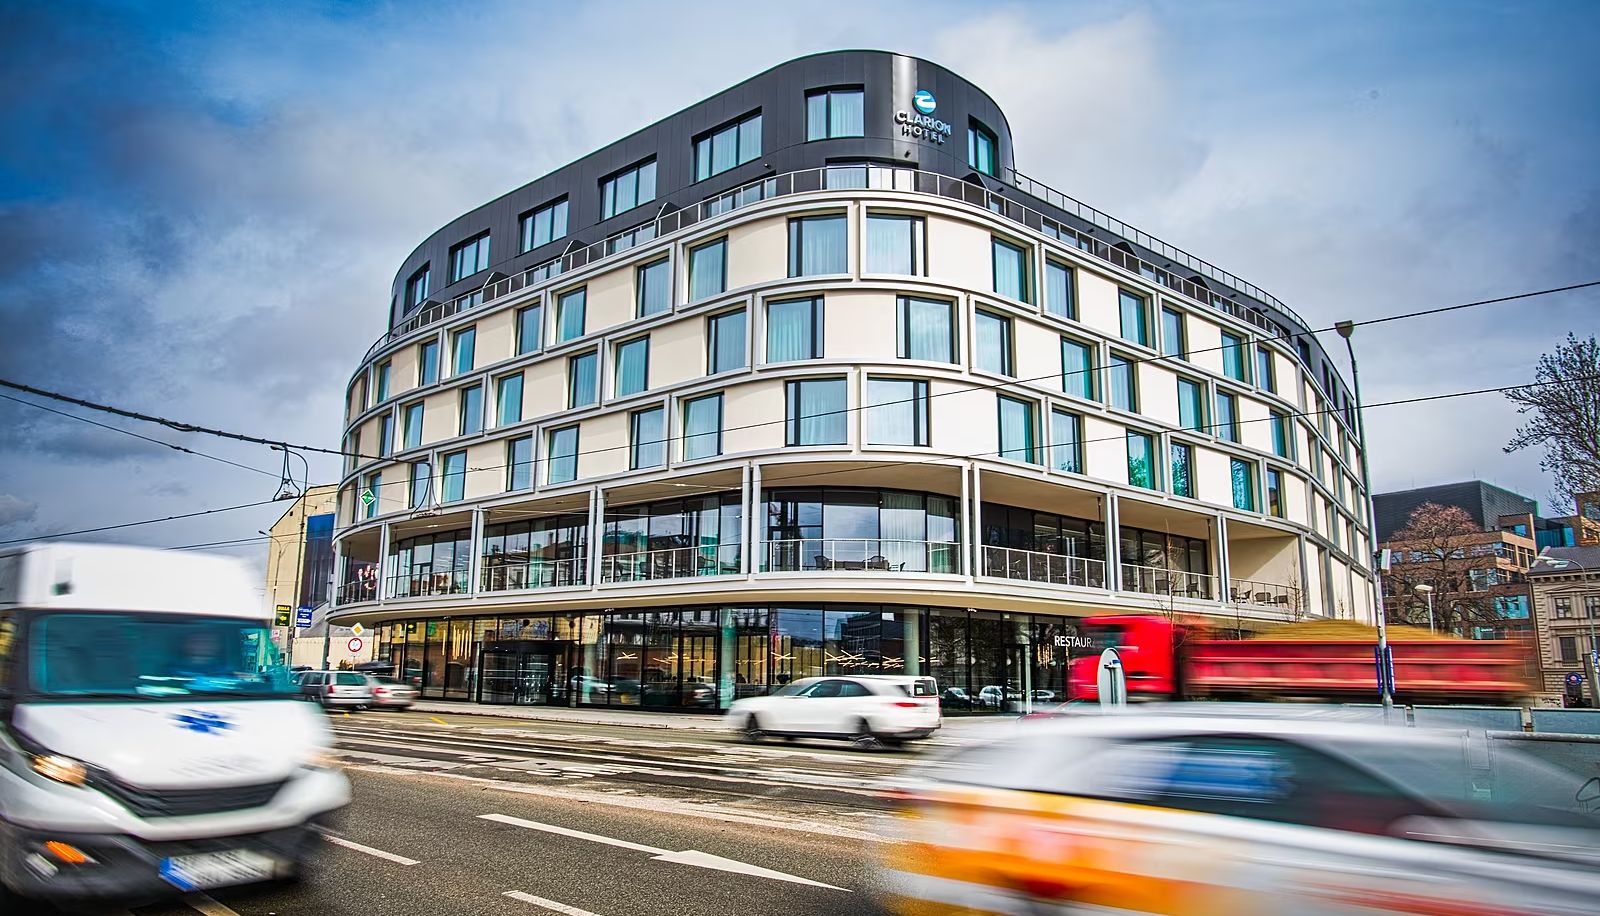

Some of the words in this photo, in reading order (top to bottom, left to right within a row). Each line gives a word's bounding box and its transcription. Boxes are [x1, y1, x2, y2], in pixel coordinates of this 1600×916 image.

[896, 110, 951, 135] CLARION
[903, 124, 945, 143] HOTEL
[1054, 635, 1095, 648] RESTAUR
